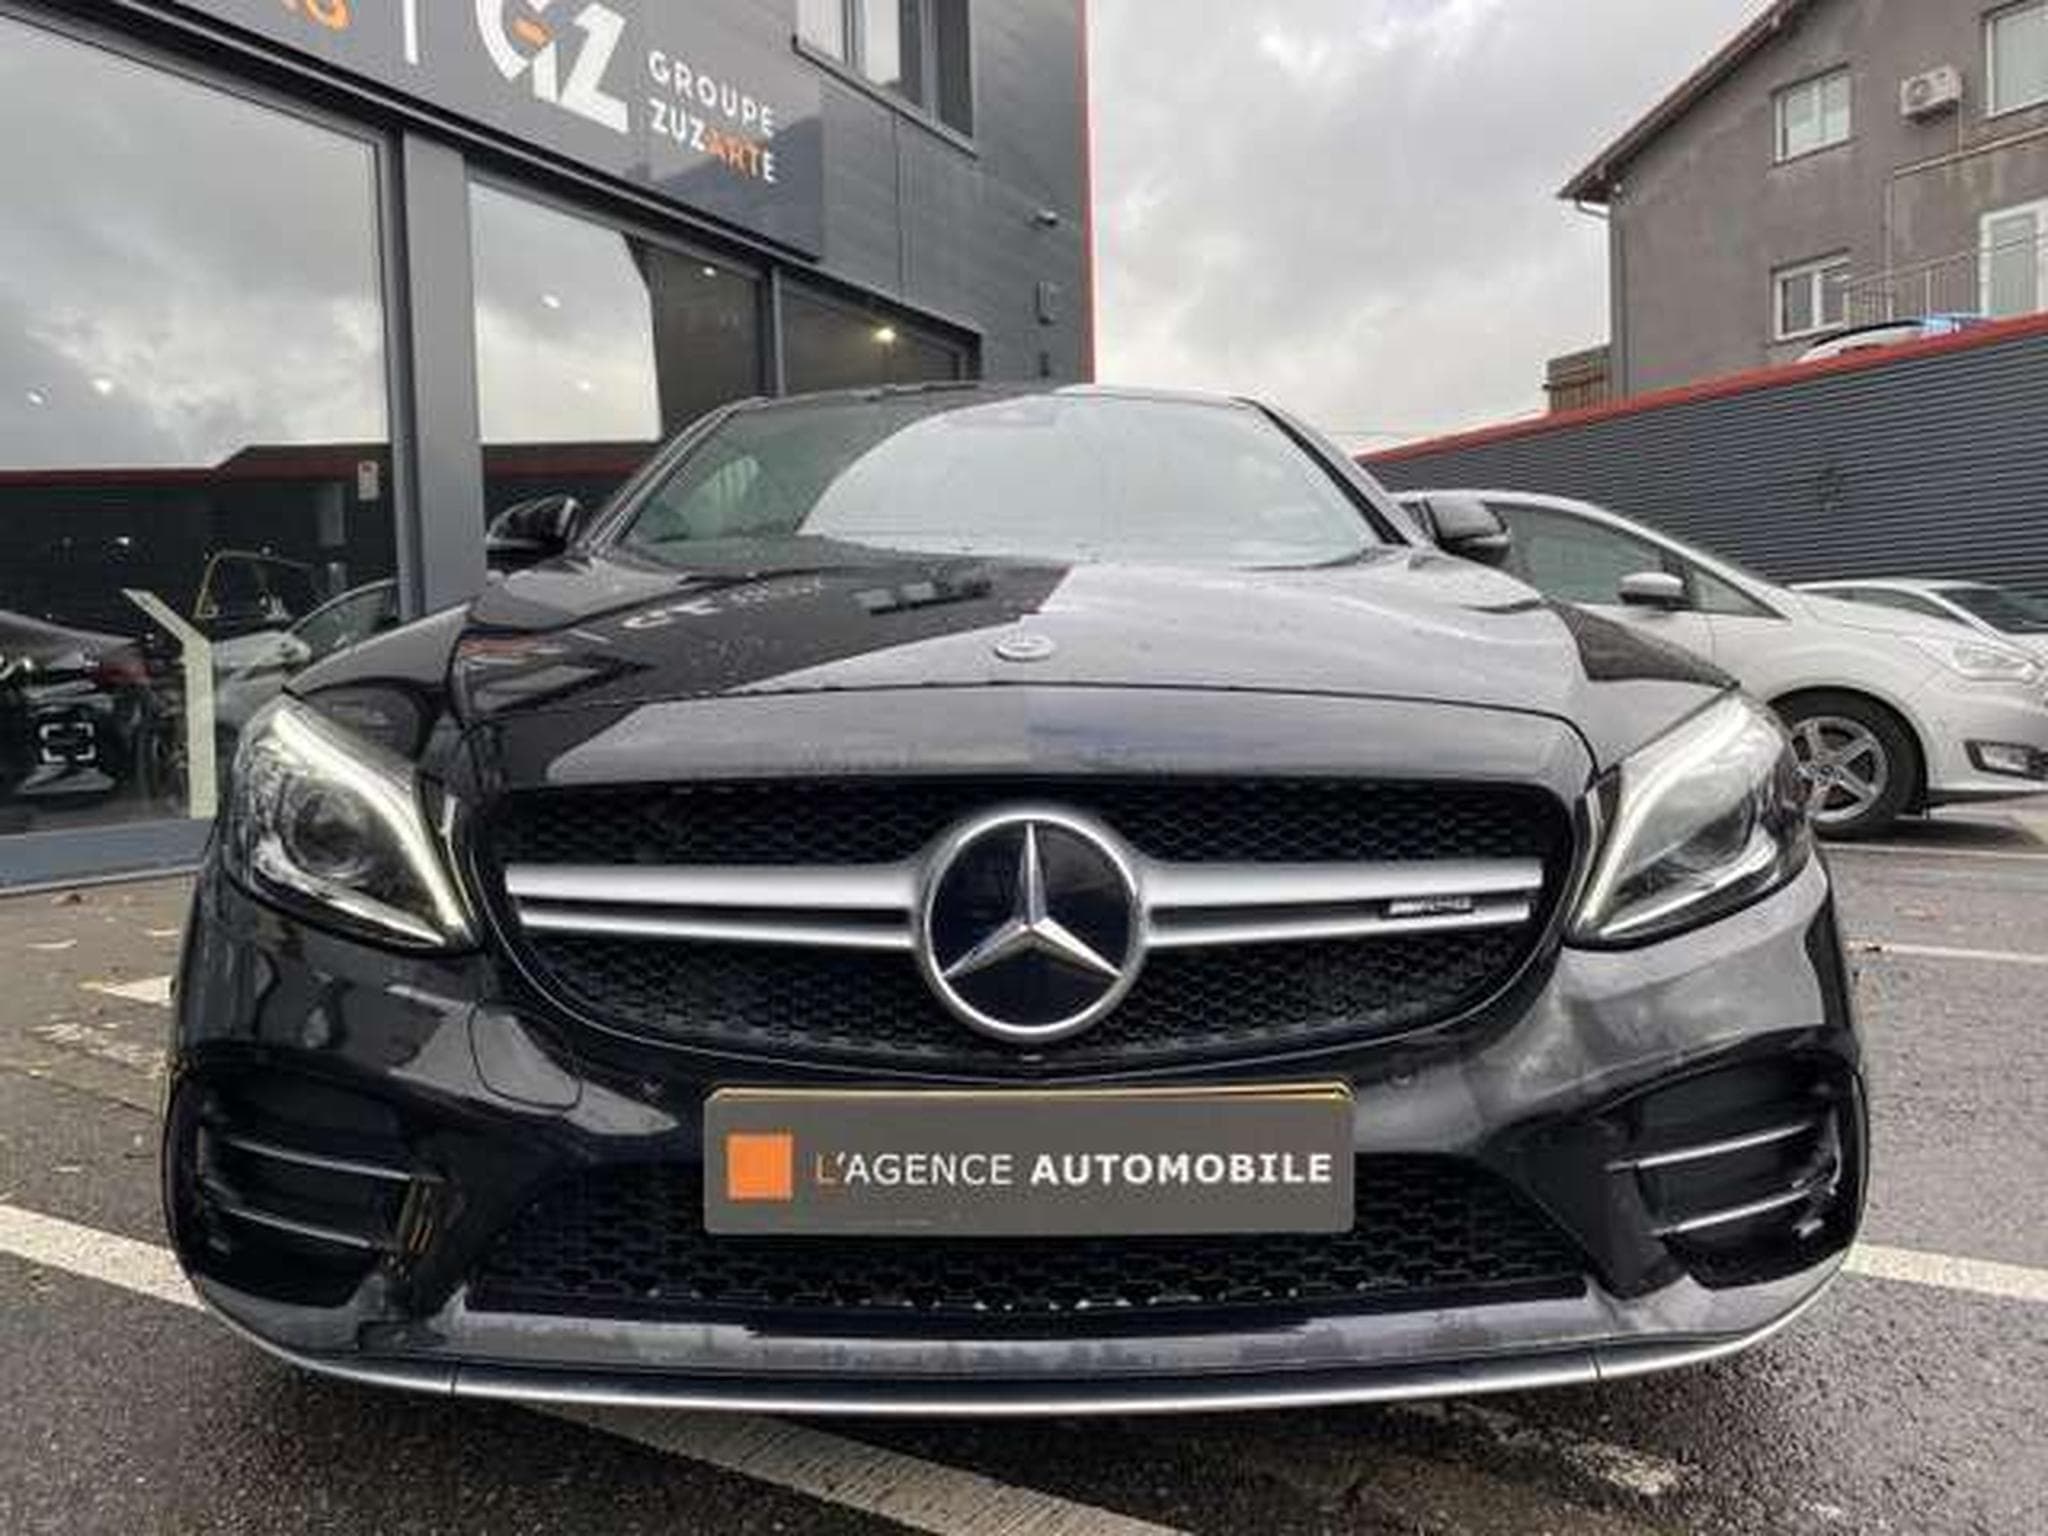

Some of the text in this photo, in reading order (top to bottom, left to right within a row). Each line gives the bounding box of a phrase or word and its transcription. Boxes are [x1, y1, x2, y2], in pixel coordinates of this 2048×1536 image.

[649, 50, 774, 137] GROUPE
[649, 97, 777, 183] ZUZARTE
[816, 1152, 1333, 1185] L'AGENCE AUTOMOBILE
